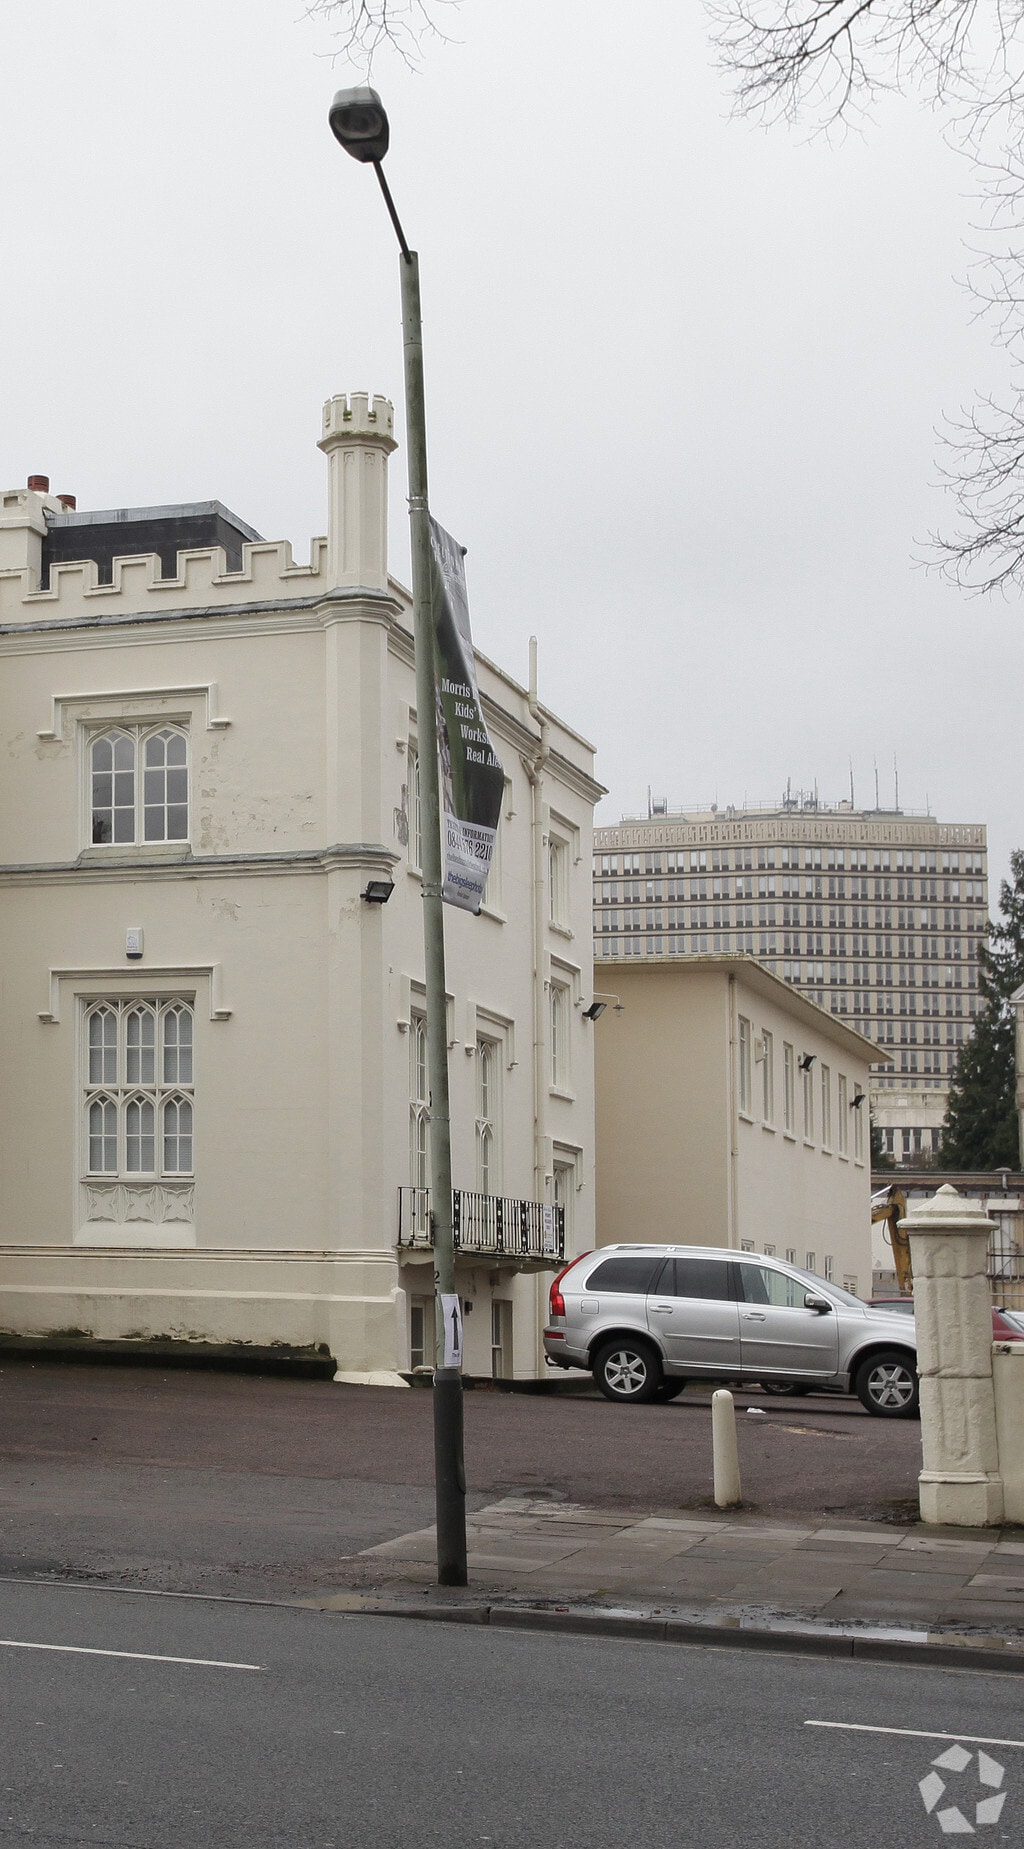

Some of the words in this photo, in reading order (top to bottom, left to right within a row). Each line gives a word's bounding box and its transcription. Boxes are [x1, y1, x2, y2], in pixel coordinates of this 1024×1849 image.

[441, 678, 471, 697] Morris
[455, 702, 477, 720] Kids'
[466, 746, 485, 764] Real
[486, 752, 503, 769] Ales
